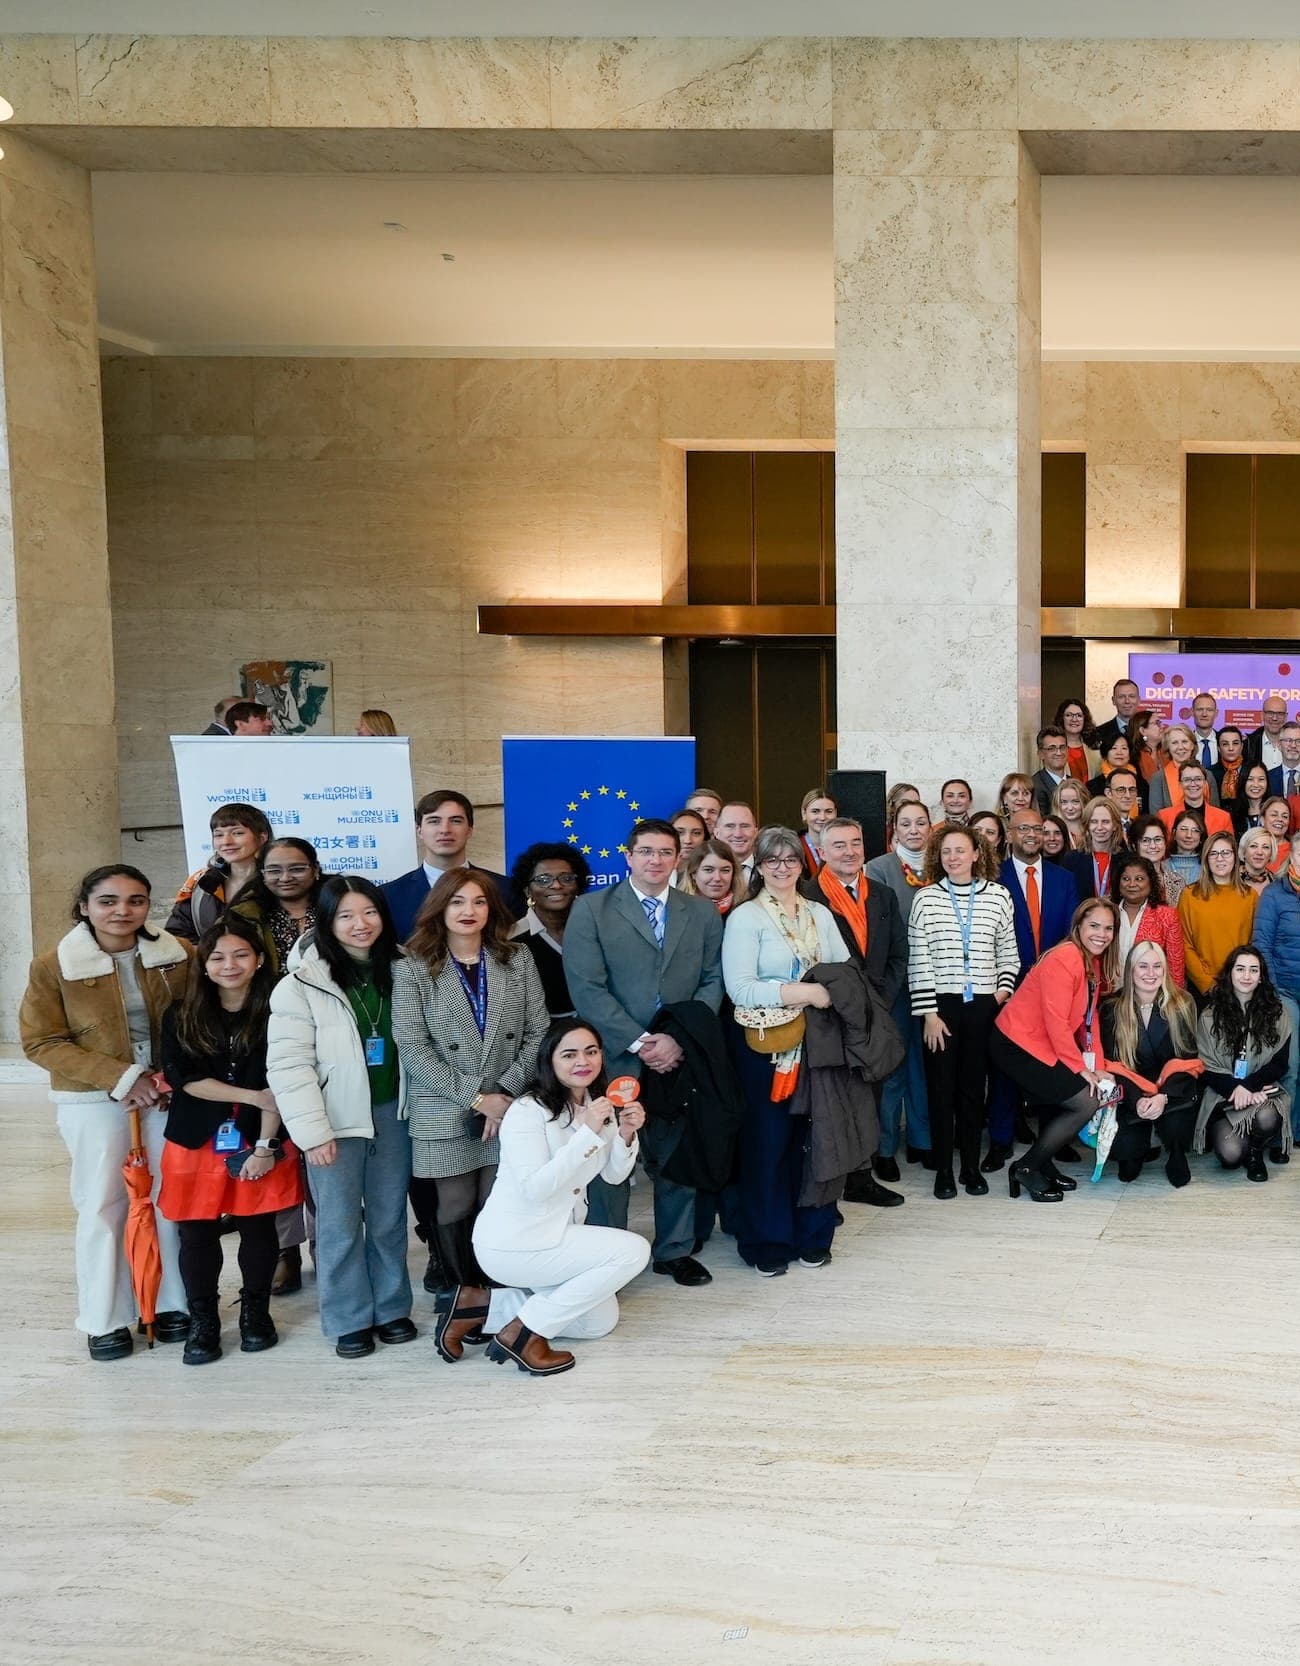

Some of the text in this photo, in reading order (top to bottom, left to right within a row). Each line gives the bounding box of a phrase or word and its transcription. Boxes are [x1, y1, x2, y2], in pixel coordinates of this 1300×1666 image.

[1208, 687, 1266, 700] SAFETY
[303, 793, 358, 801] ЖЕНЩИНЫ
[360, 809, 383, 817] ONU
[337, 816, 384, 824] MUJERES
